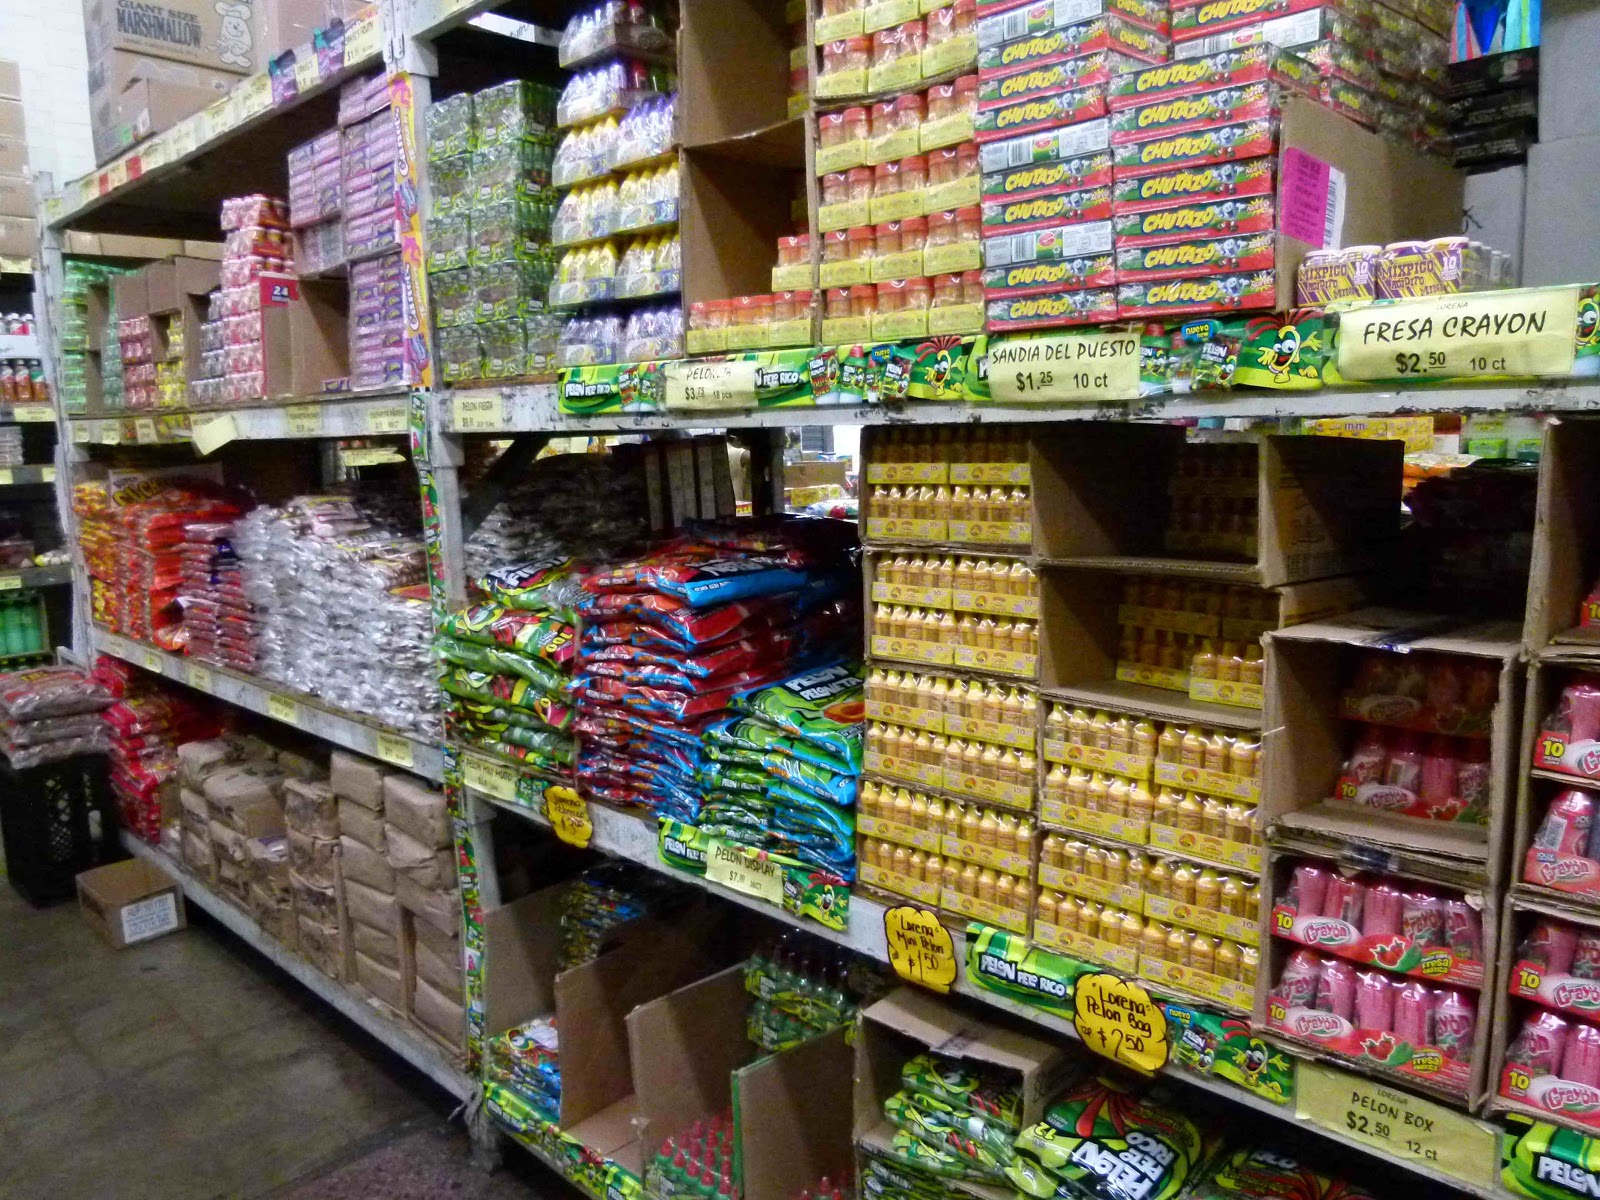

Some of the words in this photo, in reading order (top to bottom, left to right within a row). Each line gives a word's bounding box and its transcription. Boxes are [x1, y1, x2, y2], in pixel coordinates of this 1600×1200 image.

[167, 9, 198, 22] SIZE
[1002, 33, 1061, 64] CHUTAZO
[1001, 66, 1060, 97] CHUTAZO
[1137, 60, 1208, 91] CHUTAZO
[997, 99, 1056, 127] CHUTAZO
[1138, 96, 1209, 127] CHUTAZO
[1141, 133, 1211, 163] CHUTAZO
[1005, 164, 1064, 192] CHUTAZO
[1141, 170, 1213, 198] CHUTAZO
[1005, 197, 1064, 223] CHUTAZO
[1143, 206, 1215, 233] CHUTAZO
[1145, 243, 1216, 268] CHUTAZO
[1356, 261, 1368, 274] 10
[1443, 256, 1456, 270] 10
[1008, 262, 1066, 286] CHUTAZO
[1300, 264, 1347, 282] MIXPICO
[1382, 260, 1434, 280] MIXPICO
[1147, 280, 1218, 304] CHUTAZO
[1010, 298, 1069, 318] CHUTAZO
[1185, 324, 1209, 336] nuevo
[1363, 318, 1432, 345] FRESA
[1442, 310, 1547, 338] CRAYON
[992, 345, 1040, 364] SANDIA
[1045, 342, 1071, 360] DEL
[1077, 339, 1136, 357] PUESTO
[1470, 357, 1487, 372] 10
[1491, 357, 1506, 371] ct
[1073, 373, 1089, 388] 10
[1094, 372, 1108, 387] ct
[1543, 741, 1565, 757] 10
[1341, 784, 1357, 797] 10
[664, 837, 686, 856] PELON
[715, 846, 742, 867] PELON
[743, 857, 776, 878] DISPLAY
[1276, 913, 1293, 929] 10
[896, 930, 917, 950] Mini
[920, 936, 944, 954] Pelon
[981, 954, 1015, 979] PELON
[1017, 971, 1038, 987] PELO
[1040, 977, 1065, 996] RICO
[1519, 971, 1540, 989] 10
[1086, 996, 1121, 1022] Pelon
[1128, 1013, 1151, 1038] Bag
[1169, 1008, 1191, 1019] nuevo
[1269, 1004, 1286, 1020] 10
[1509, 1071, 1530, 1090] 10
[1352, 1092, 1399, 1120] PELON
[1404, 1111, 1434, 1133] BOX
[1125, 1131, 1176, 1166] RICO
[1406, 1139, 1421, 1155] 12
[1425, 1149, 1438, 1161] ct
[1072, 1141, 1154, 1200] PELON
[1119, 1148, 1165, 1182] PELO
